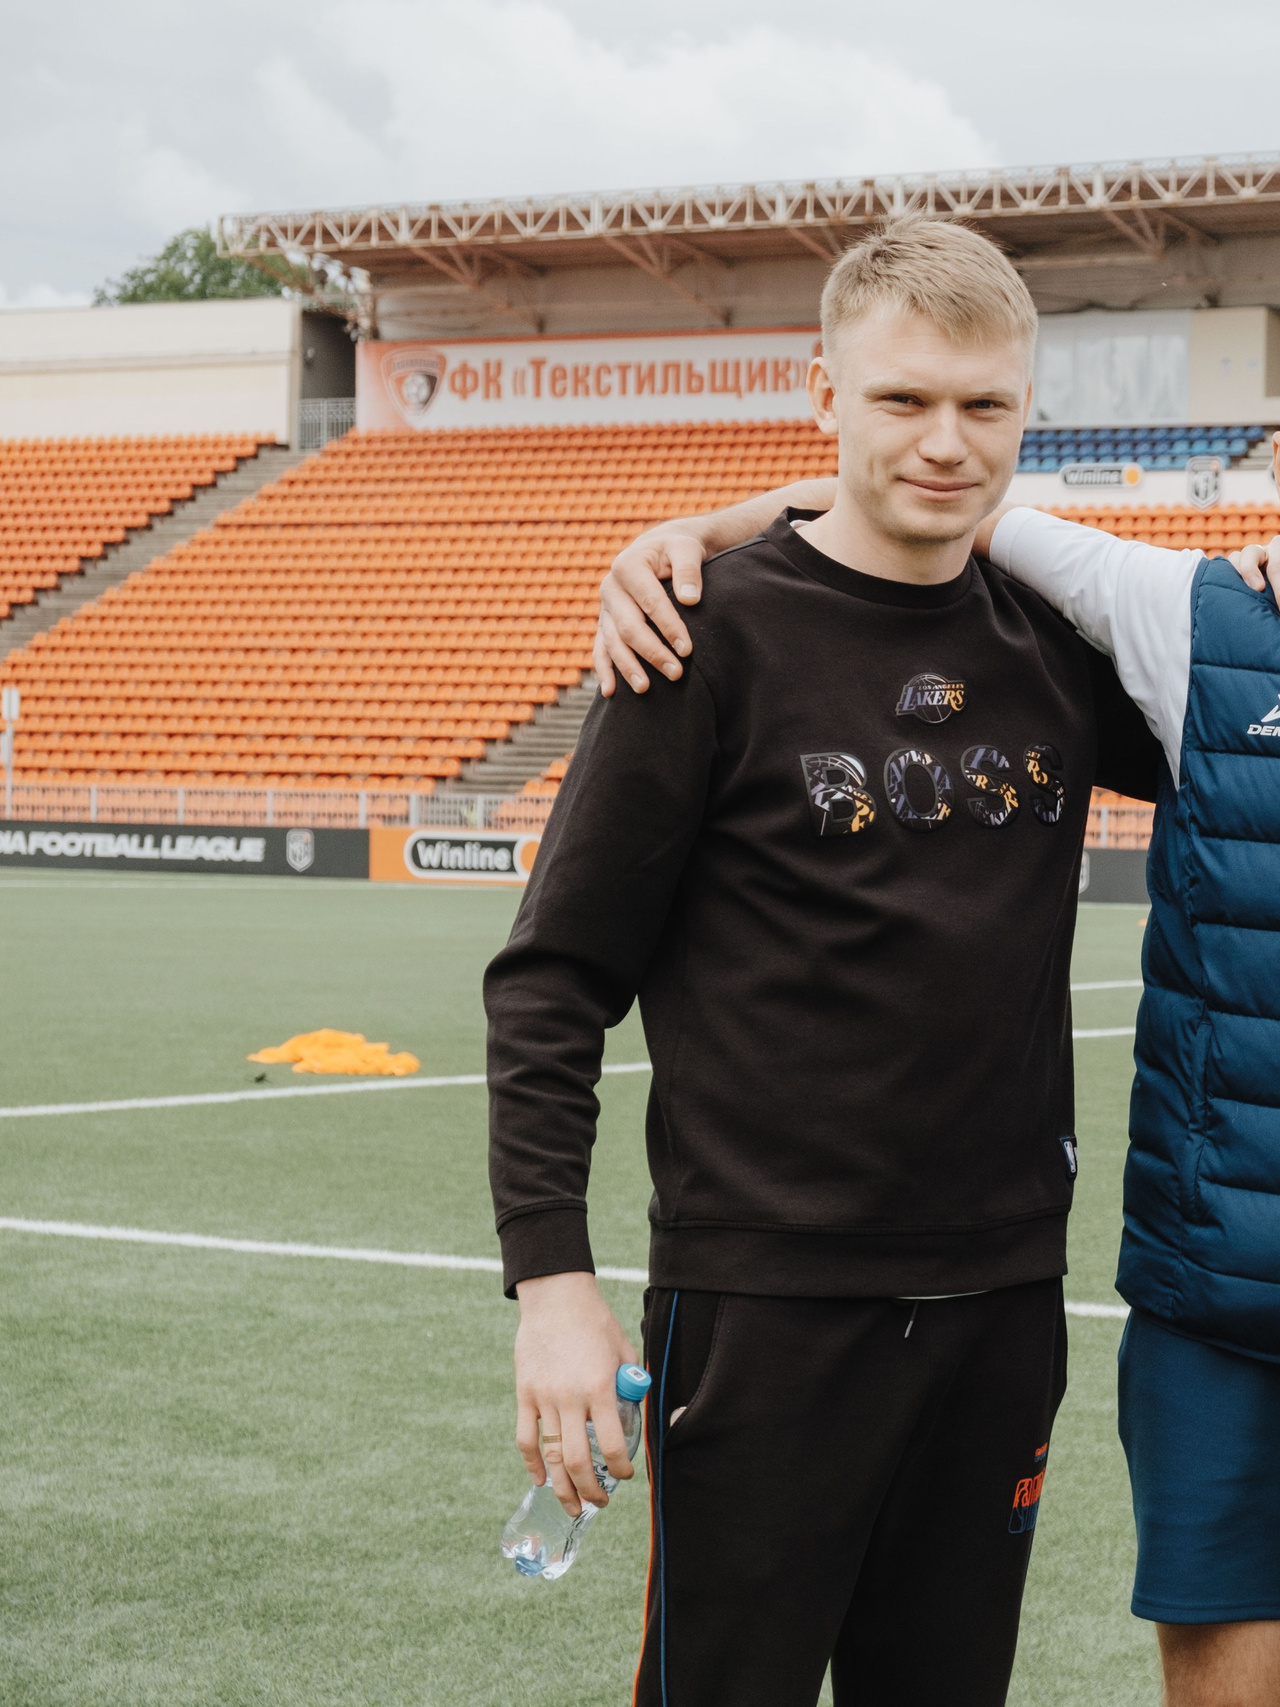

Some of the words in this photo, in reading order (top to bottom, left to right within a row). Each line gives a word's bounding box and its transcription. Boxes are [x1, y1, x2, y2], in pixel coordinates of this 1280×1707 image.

[450, 359, 502, 400] ФК
[902, 686, 965, 711] LAKERS
[800, 741, 1065, 838] BOSS
[28, 831, 160, 859] FOOTBALL
[161, 834, 266, 862] LEAGUE
[416, 840, 512, 871] Winline
